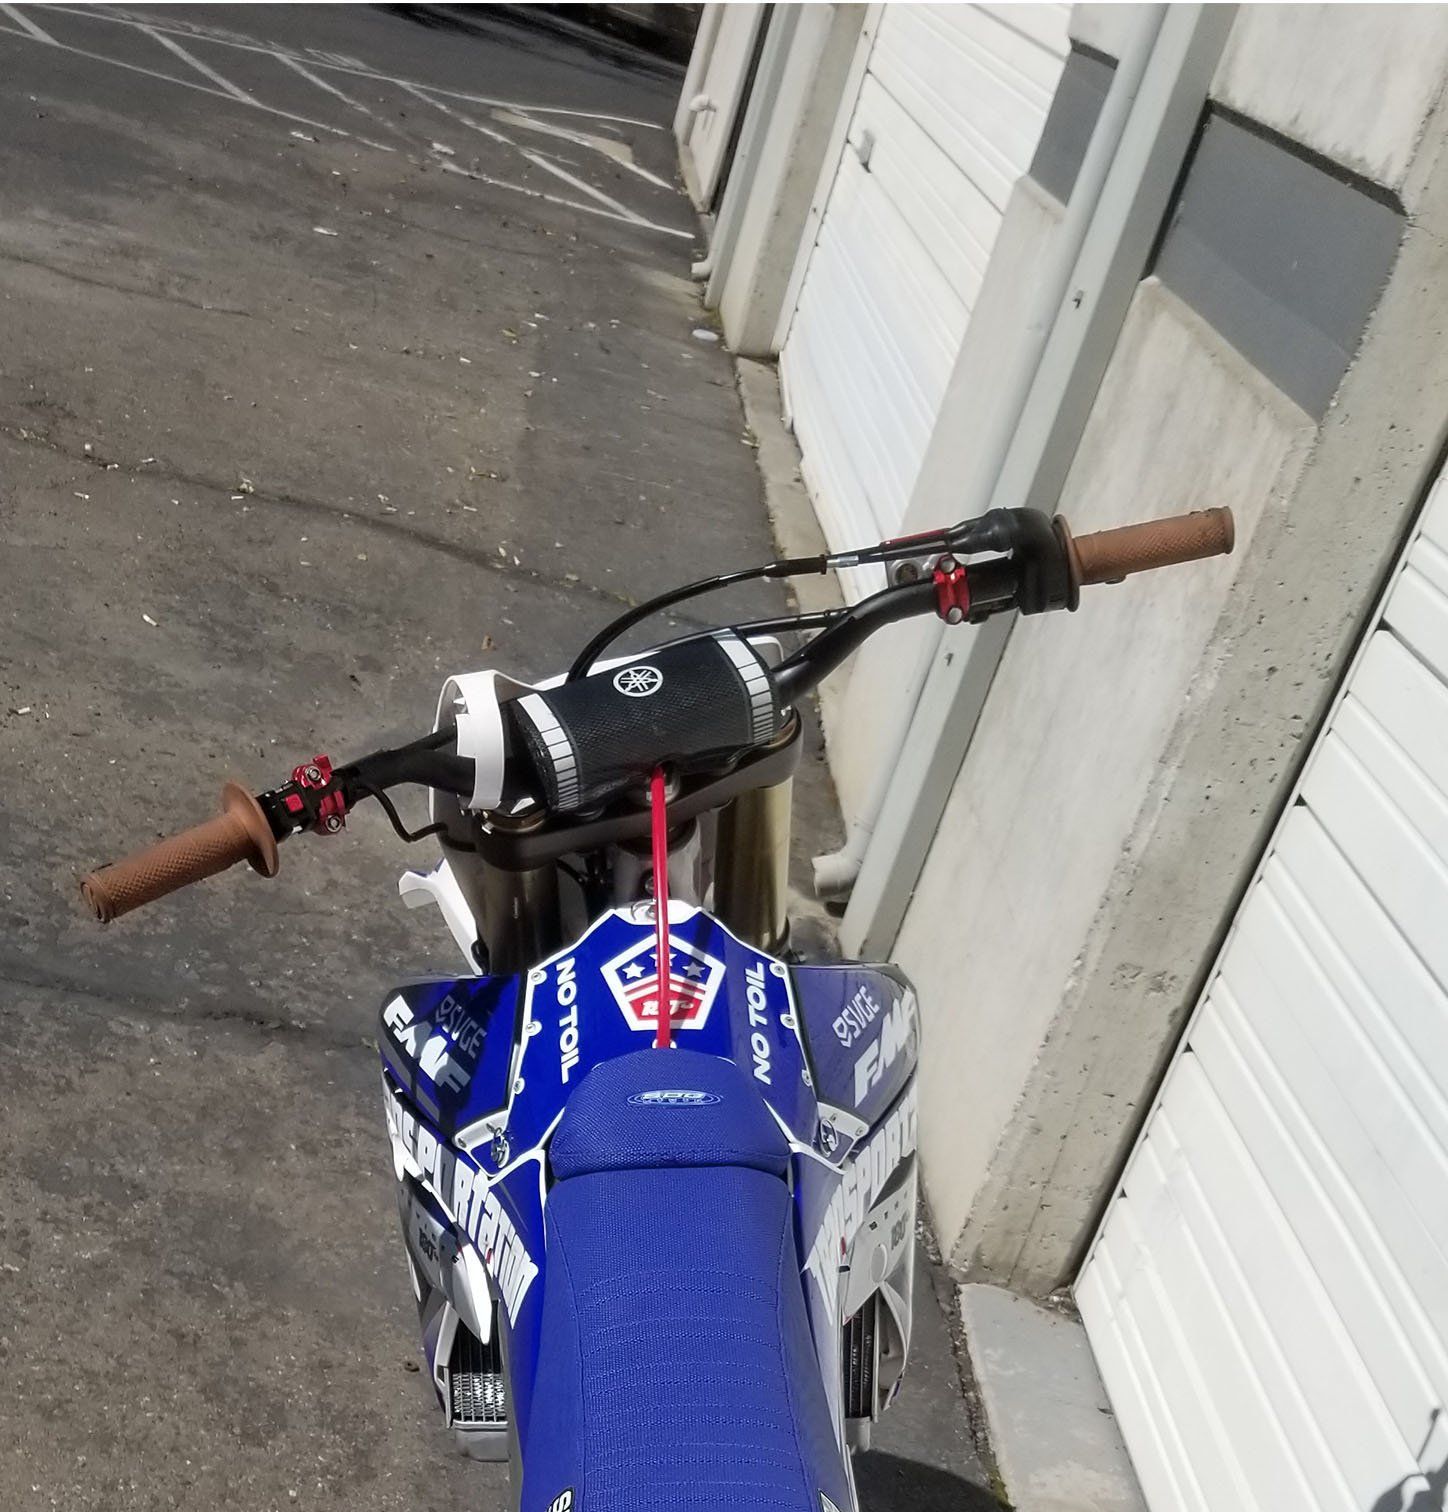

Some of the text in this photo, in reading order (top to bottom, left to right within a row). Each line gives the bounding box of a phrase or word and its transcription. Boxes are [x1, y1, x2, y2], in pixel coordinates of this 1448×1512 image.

[556, 957, 580, 1084] NO TOIL
[745, 961, 771, 1085] NO TOIL
